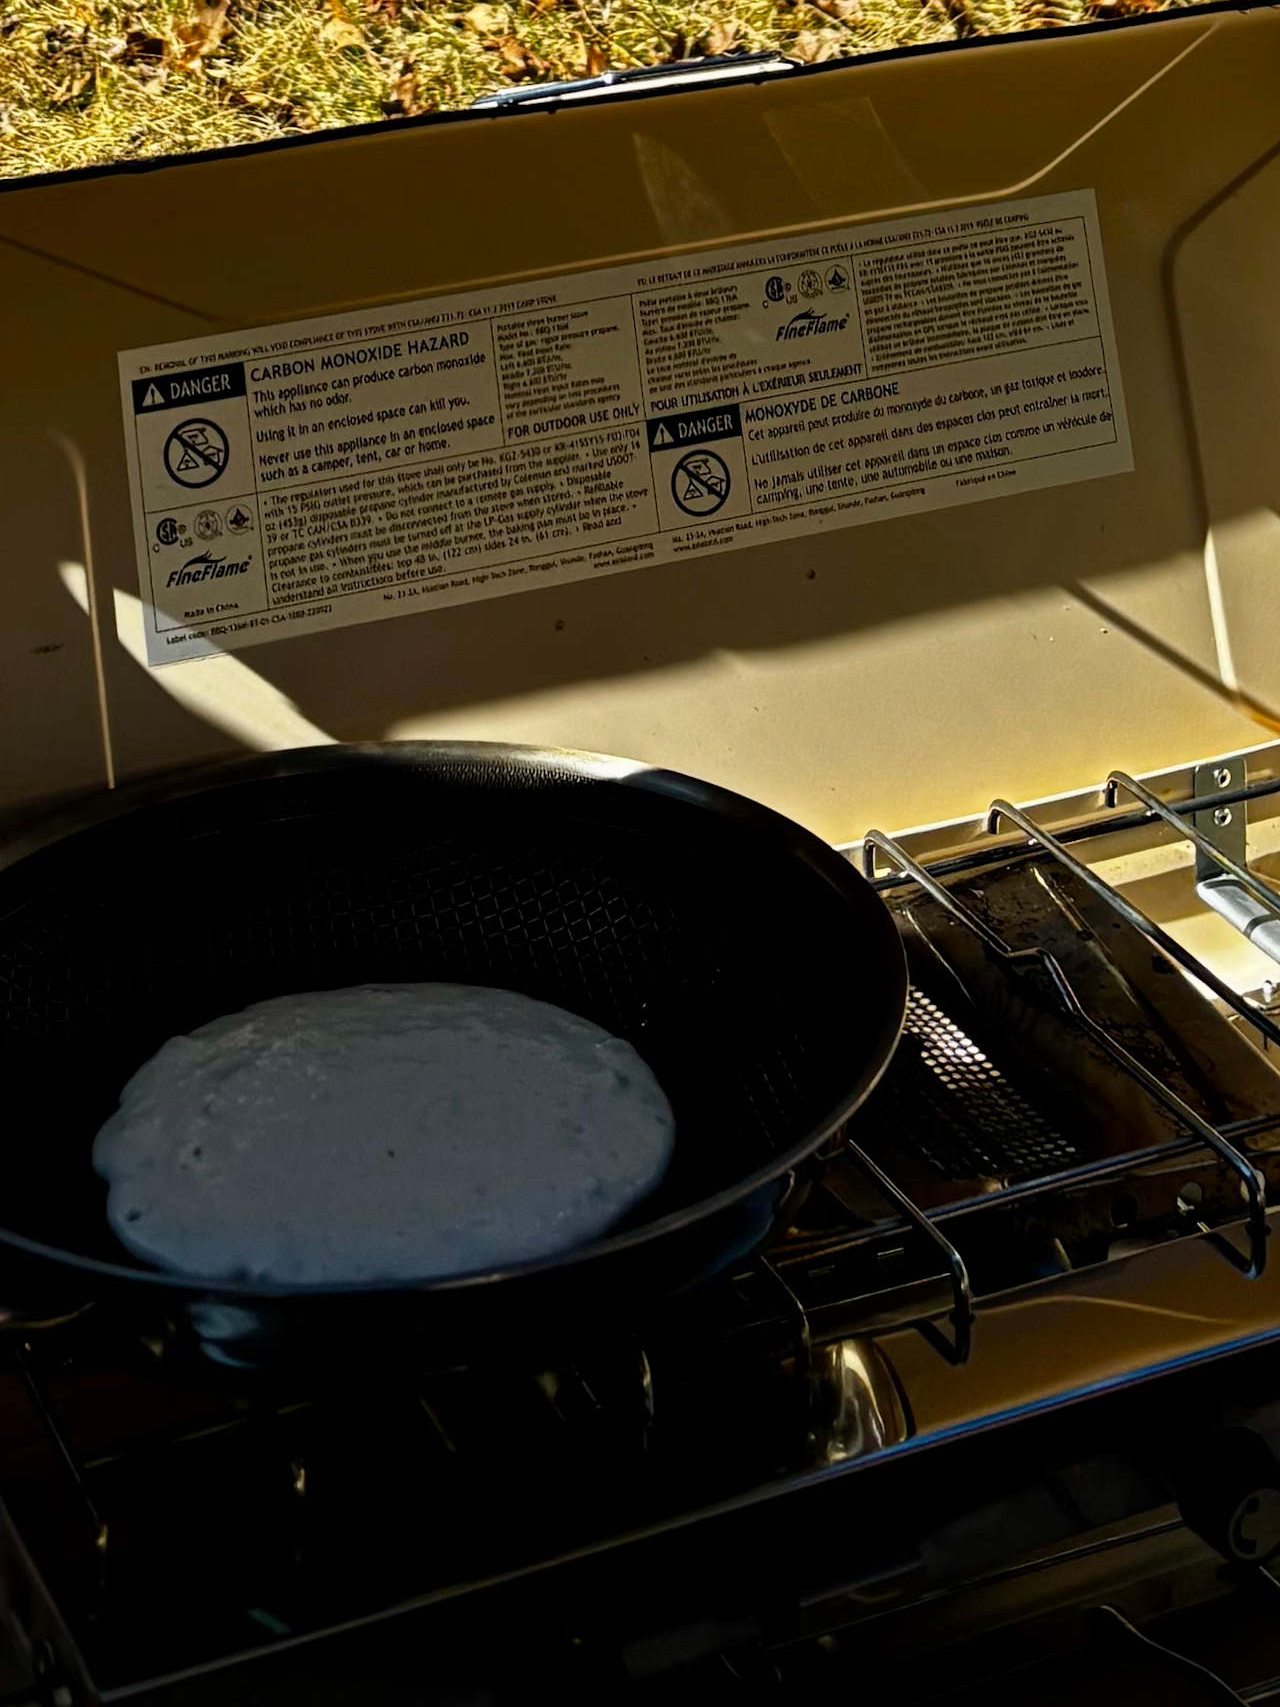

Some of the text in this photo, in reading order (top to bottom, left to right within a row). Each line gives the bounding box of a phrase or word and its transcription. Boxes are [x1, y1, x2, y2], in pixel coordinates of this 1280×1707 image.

[774, 314, 847, 341] FineFlame
[250, 358, 315, 382] CARBON
[320, 343, 403, 371] MONOXIDE
[407, 331, 469, 356] HAZARD
[253, 352, 486, 404] This appliance can produce carbon monoxide
[170, 374, 230, 399] DANGER
[253, 393, 352, 419] which has no odor.
[651, 395, 679, 413] POUR
[681, 385, 739, 407] UTILISATION
[742, 381, 750, 396] À
[808, 363, 863, 383] SEULEMENT
[745, 381, 900, 424] MONOXYDE DE CARBONE
[748, 428, 765, 442] Cet
[767, 419, 806, 439] appareil
[807, 416, 830, 432] peut
[831, 409, 871, 427] produire
[873, 406, 885, 418] du
[934, 394, 947, 406] du
[990, 385, 1002, 396] un
[1004, 381, 1020, 395] gaz
[1022, 375, 1055, 390] toxique
[1056, 371, 1067, 383] et
[256, 396, 470, 443] Using it in an enclosed space can kill you.
[259, 415, 495, 467] Never use this appliance in an enclosed space
[507, 403, 640, 439] FOR OUTDOOR USE ONLY
[679, 414, 732, 437] DANGER
[812, 442, 826, 454] de
[828, 438, 846, 451] cet
[848, 428, 889, 448] appareil
[890, 427, 914, 439] dans
[916, 421, 934, 434] des
[935, 414, 974, 430] espaces
[976, 409, 996, 422] clos
[998, 404, 1021, 420] peut
[1070, 393, 1080, 404] la
[260, 439, 451, 483] such as a camper, tent, car or home.
[753, 478, 769, 491] Ne
[772, 470, 805, 489] jamais
[807, 464, 842, 480] utiliser
[845, 459, 861, 472] cet
[864, 449, 905, 470] appareil
[907, 447, 930, 460] dans
[932, 444, 945, 456] un
[947, 437, 981, 453] espace
[983, 433, 1003, 445] clos
[1005, 426, 1041, 441] comme
[1042, 422, 1055, 433] un
[805, 480, 826, 496] une
[861, 471, 880, 484] une
[882, 460, 938, 480] automobile
[940, 457, 953, 468] ou
[954, 453, 973, 467] une
[164, 557, 250, 588] FineFlame
